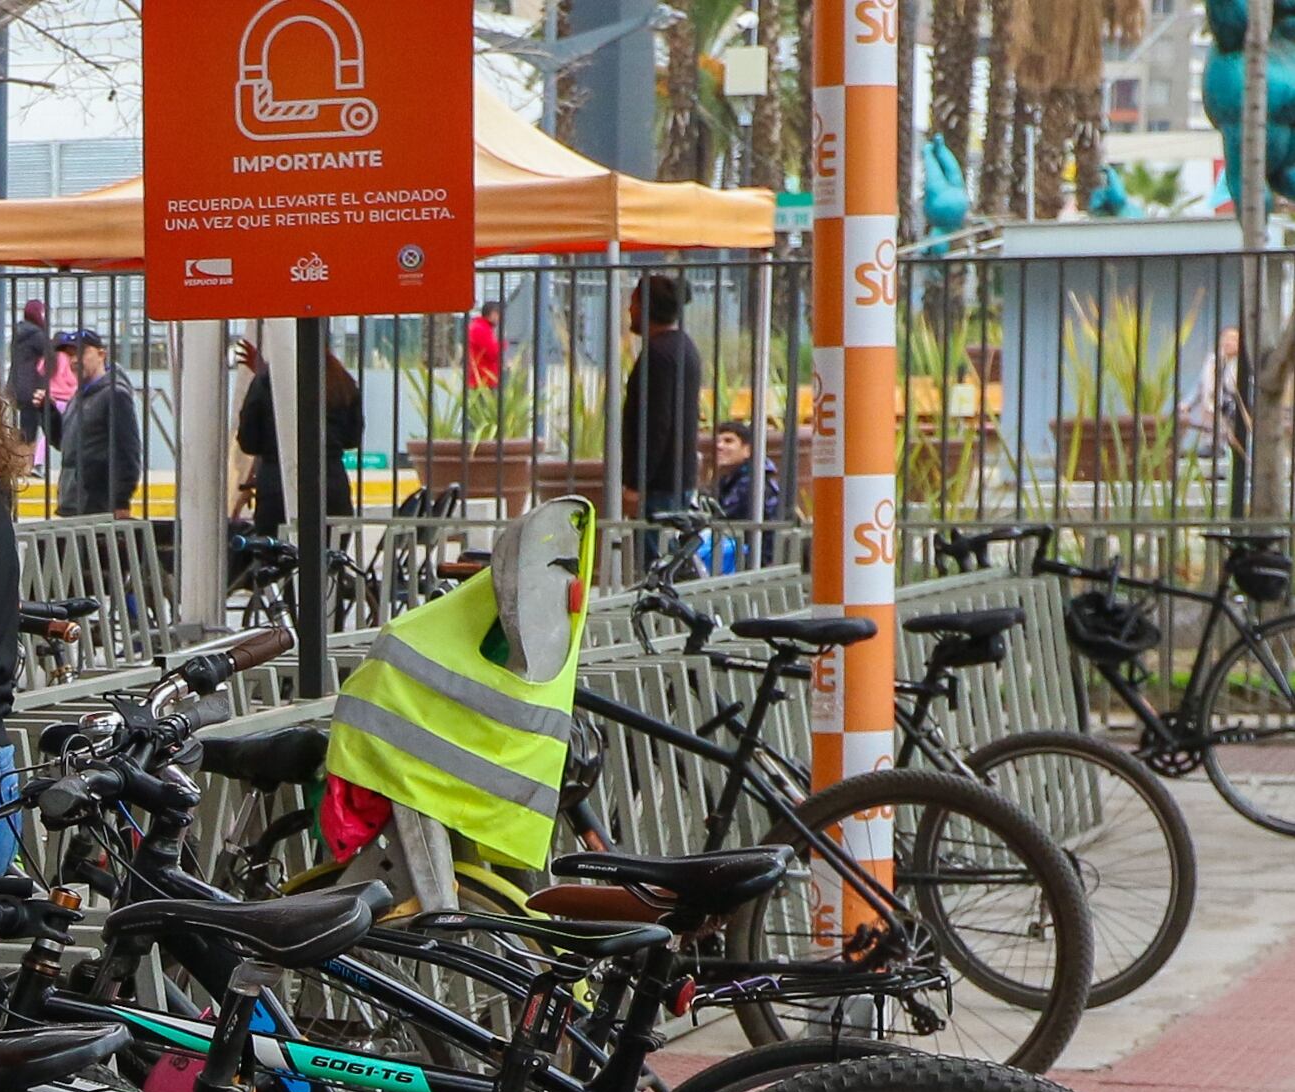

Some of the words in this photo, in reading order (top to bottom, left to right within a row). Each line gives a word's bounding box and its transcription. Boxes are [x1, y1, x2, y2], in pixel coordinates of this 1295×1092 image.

[232, 150, 382, 173] IMPORTANTE
[168, 197, 254, 213] RECUERDA
[258, 193, 337, 209] LLEVARTE
[341, 193, 361, 206] EL
[364, 188, 447, 204] CANDADO
[164, 218, 199, 231] UNA
[203, 216, 233, 230] VEZ
[237, 215, 271, 230] QUE
[276, 211, 340, 226] RETIRES
[343, 210, 365, 223] TU
[369, 207, 455, 223] BICICLETA.
[184, 277, 218, 287] VESPUCIO
[219, 276, 234, 286] SUR
[289, 264, 329, 282] SUBE
[577, 863, 618, 873] Bianchi
[311, 1054, 416, 1085] 6061-T6
